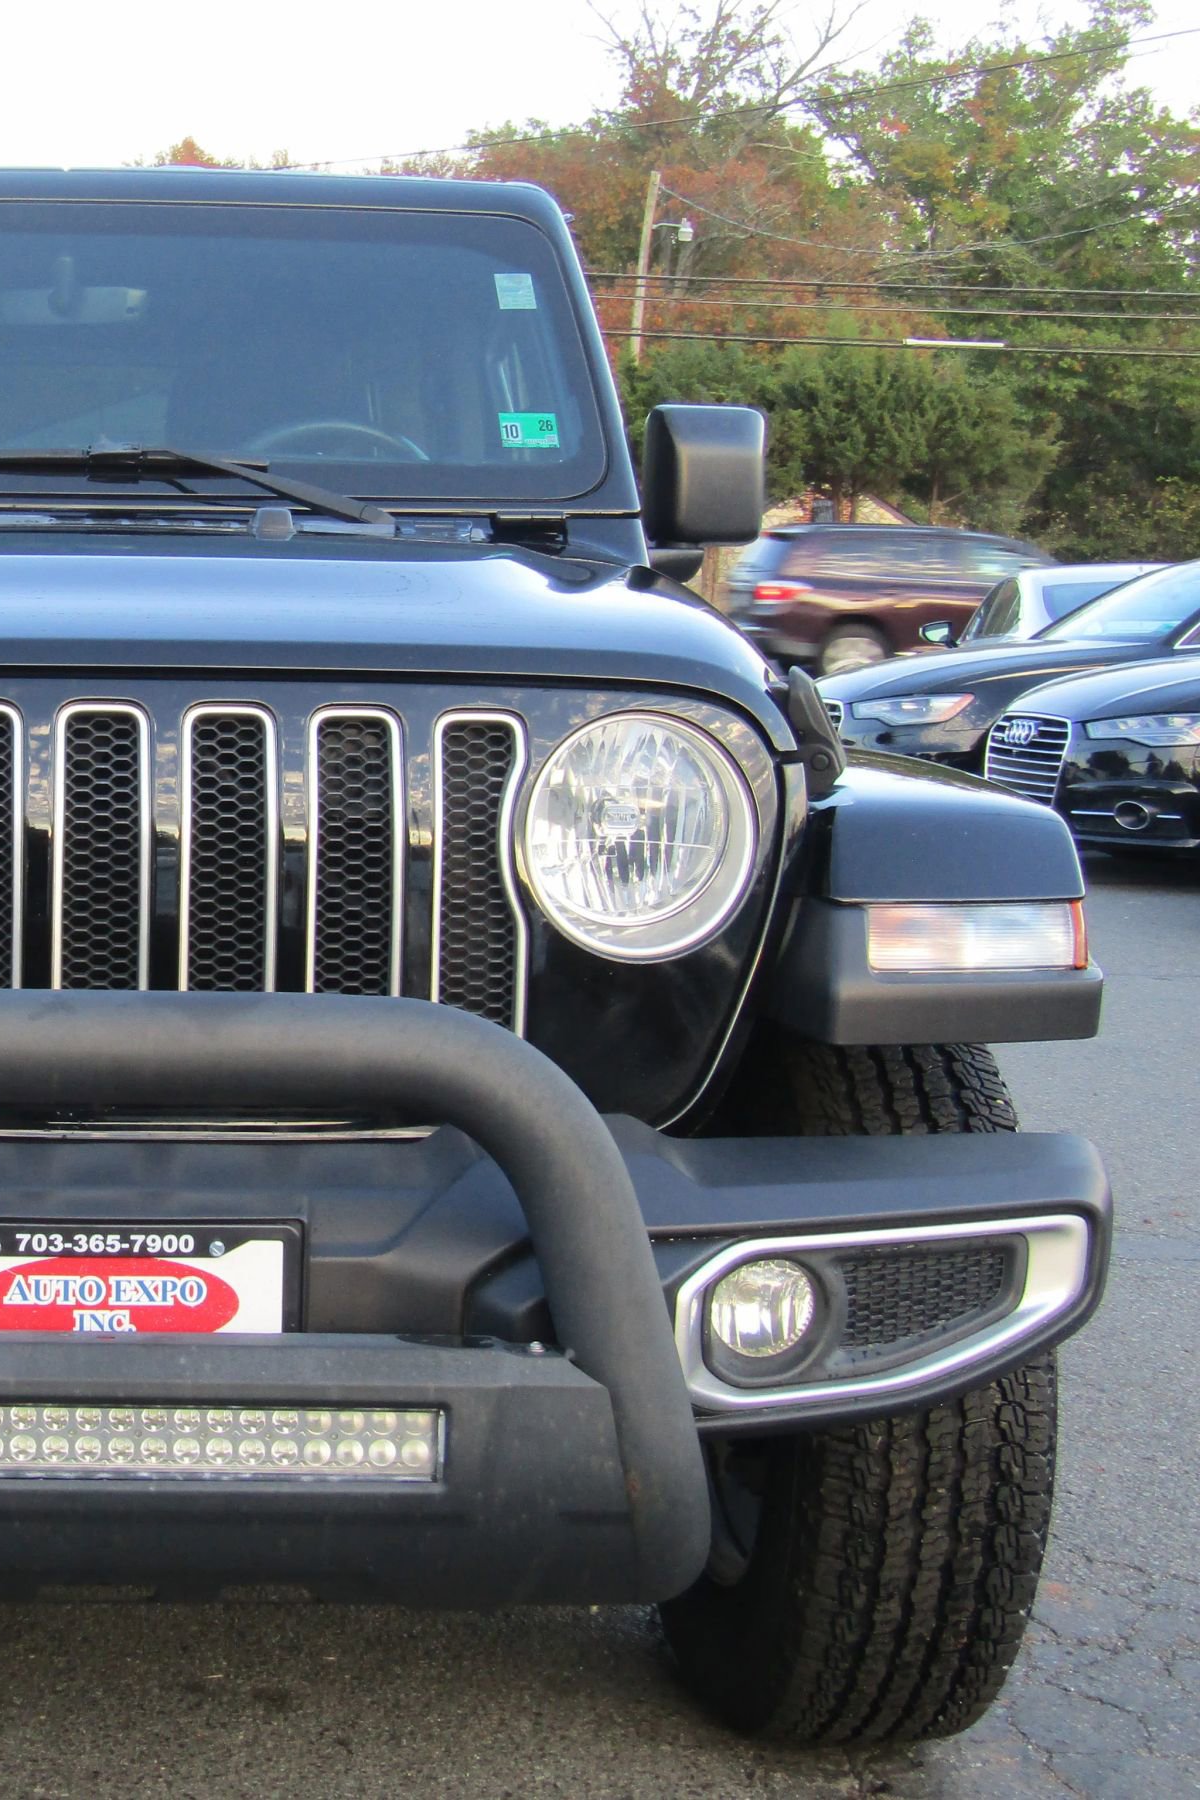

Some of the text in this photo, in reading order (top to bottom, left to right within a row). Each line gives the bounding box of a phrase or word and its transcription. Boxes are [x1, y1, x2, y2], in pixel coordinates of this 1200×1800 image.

[502, 424, 519, 439] 10
[538, 419, 553, 431] 26
[15, 1233, 195, 1253] 703-365-7900
[3, 1275, 207, 1306] AUTO EXPO
